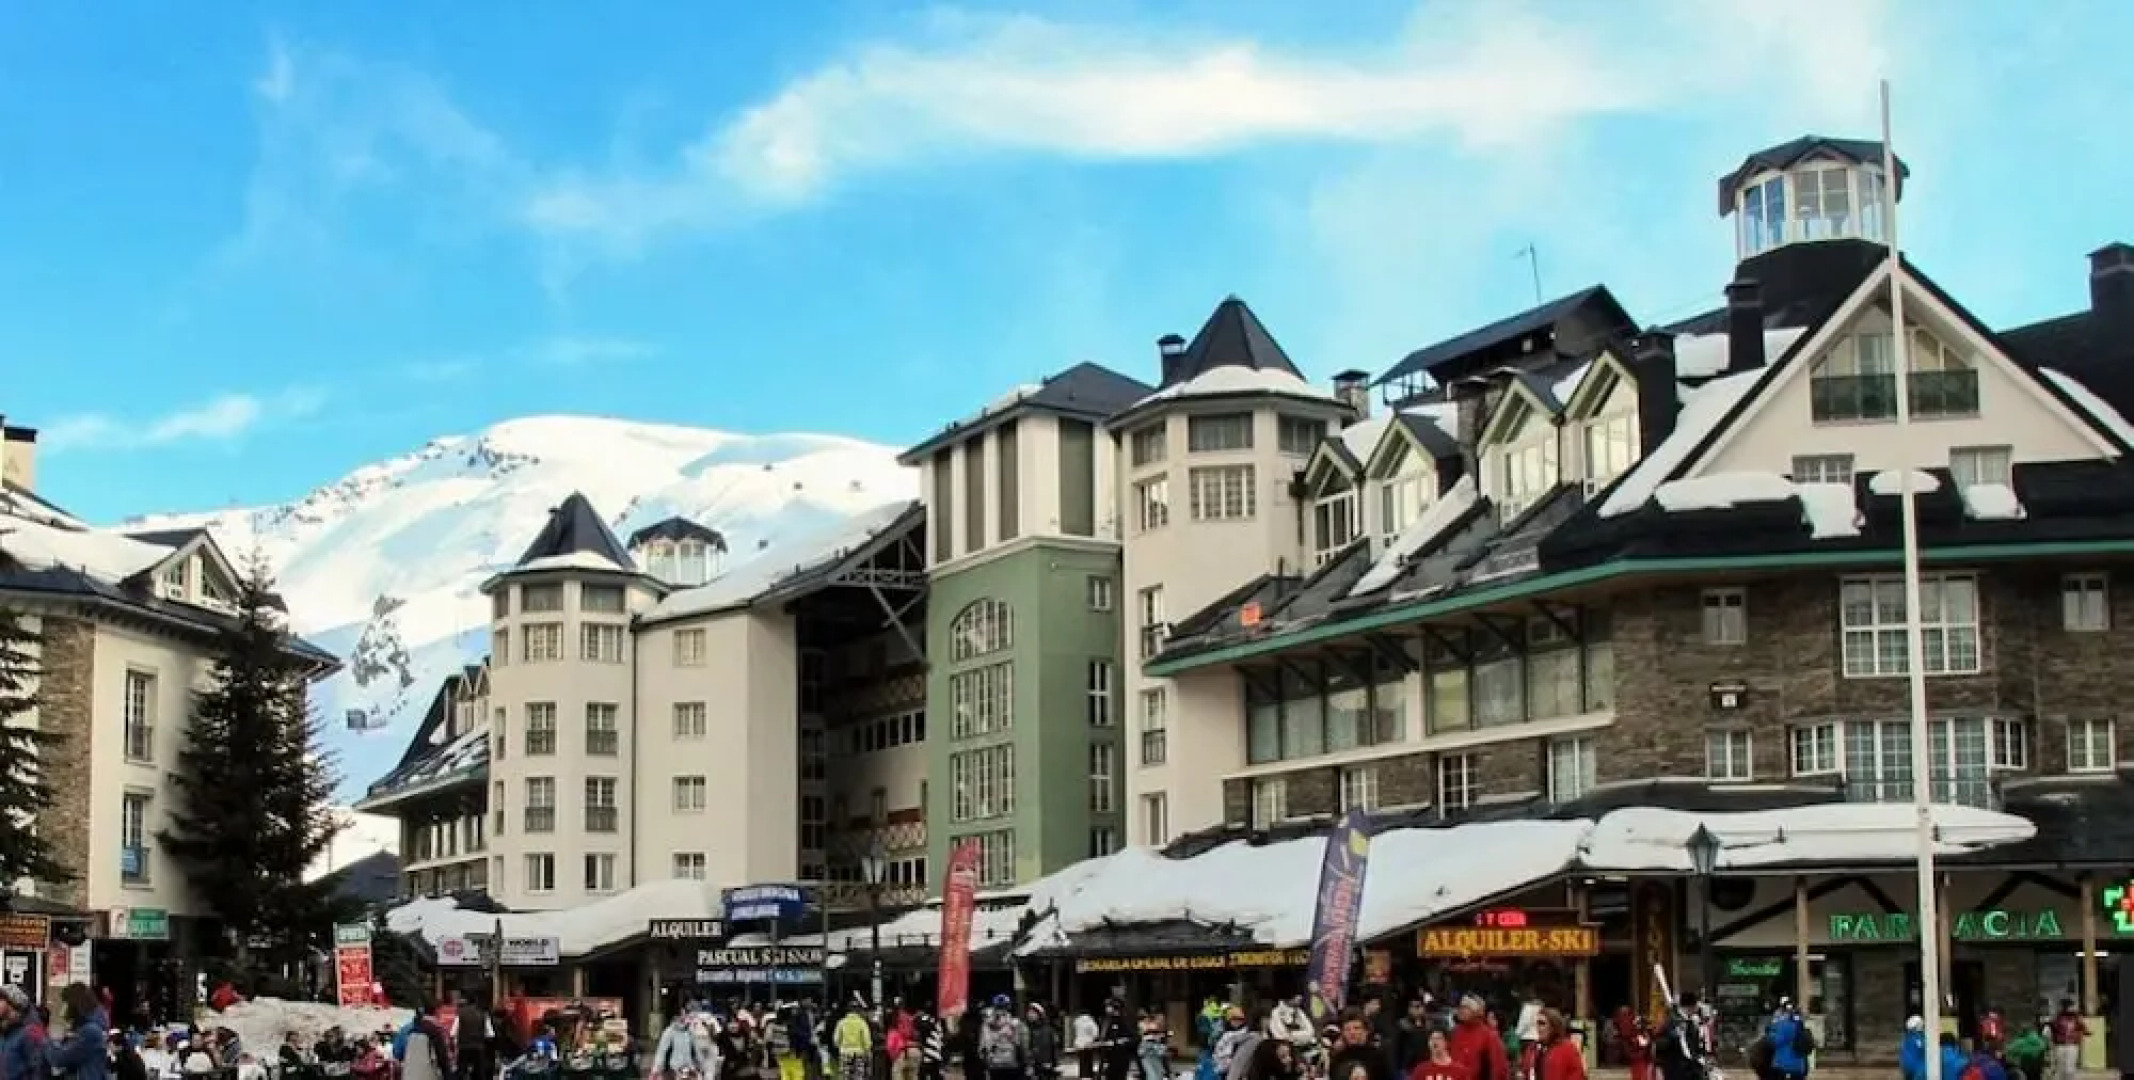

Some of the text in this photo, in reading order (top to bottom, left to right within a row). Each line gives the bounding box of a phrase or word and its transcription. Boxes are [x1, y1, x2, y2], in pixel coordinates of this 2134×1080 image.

[650, 921, 722, 940] ALQUILER
[1830, 910, 2063, 941] FARACIA
[1424, 928, 1592, 958] ALQUILER-SKI
